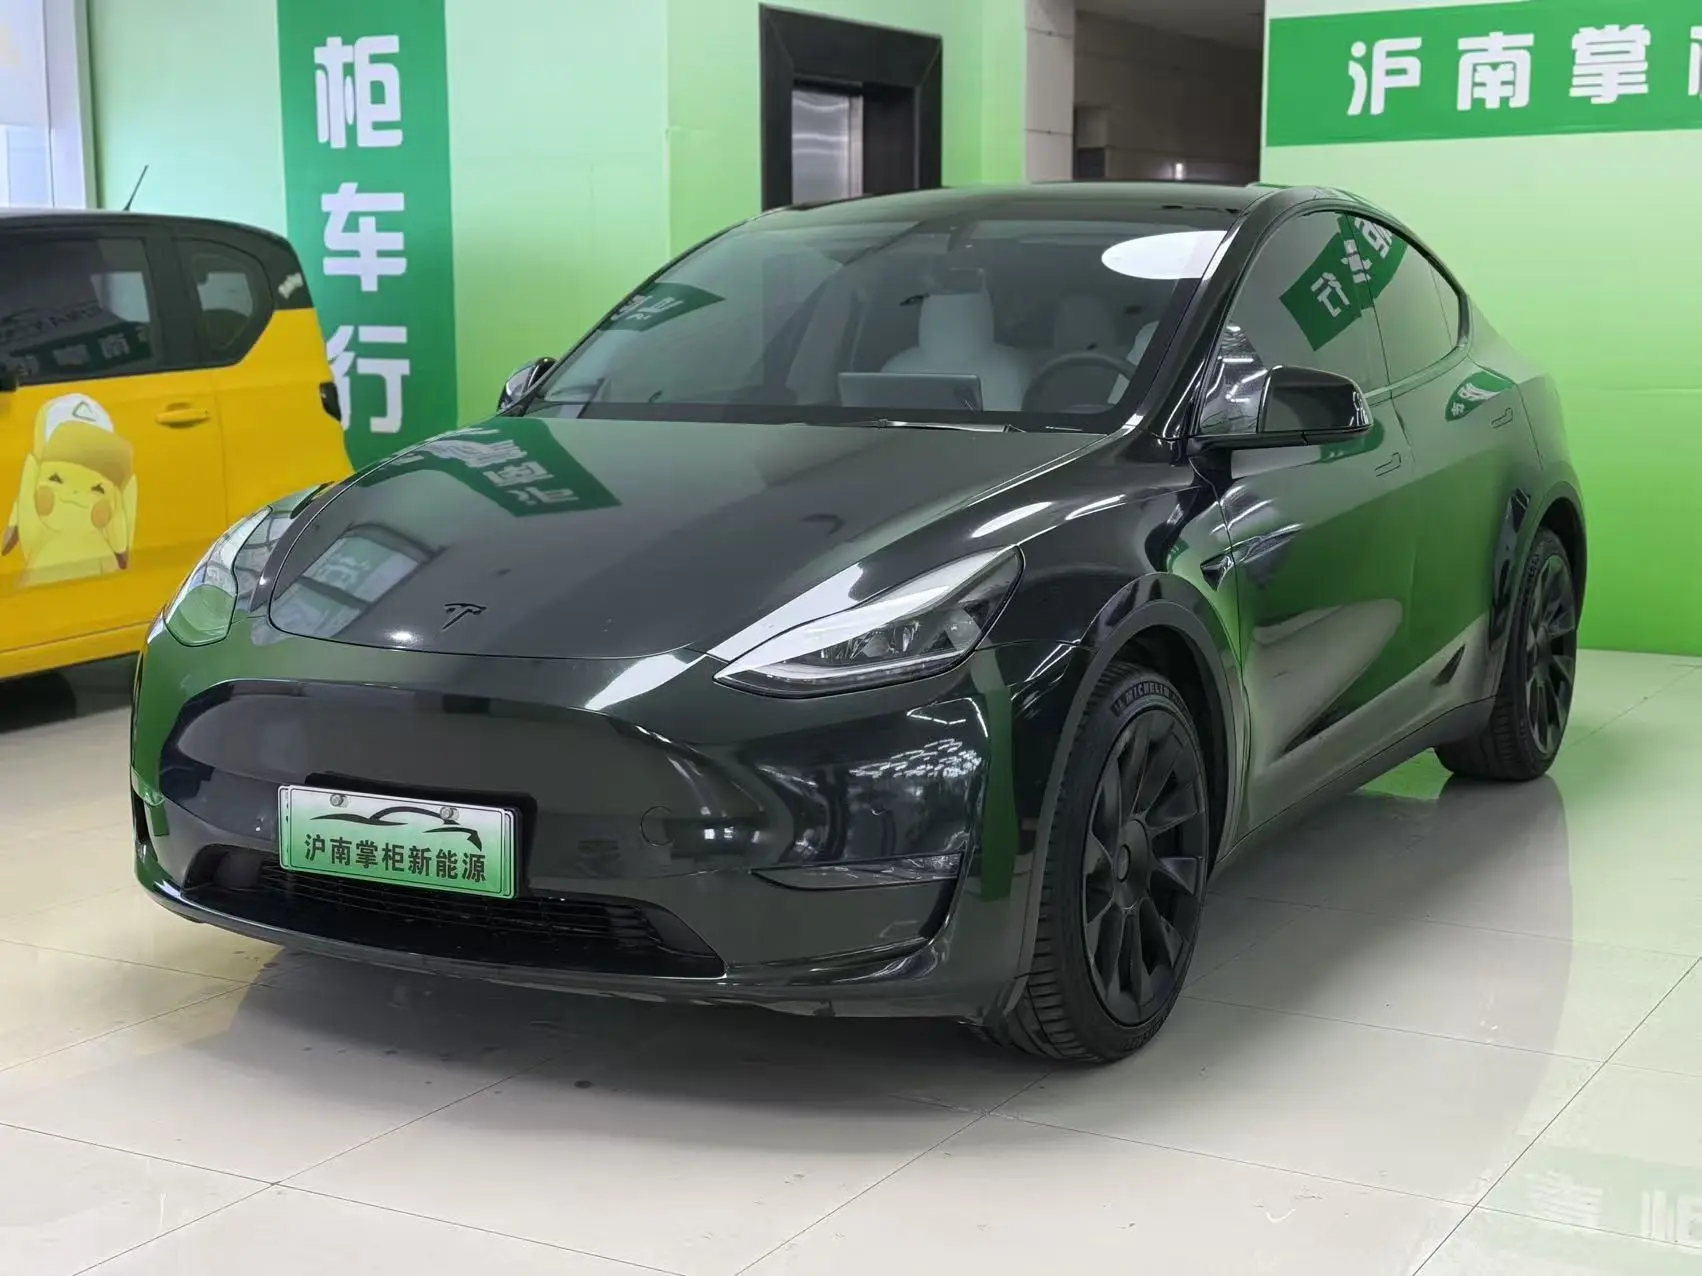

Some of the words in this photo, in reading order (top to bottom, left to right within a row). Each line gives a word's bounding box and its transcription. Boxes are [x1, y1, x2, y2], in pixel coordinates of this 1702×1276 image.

[314, 34, 410, 434] 柜车行
[304, 833, 486, 883] 沪南掌柜新能源
